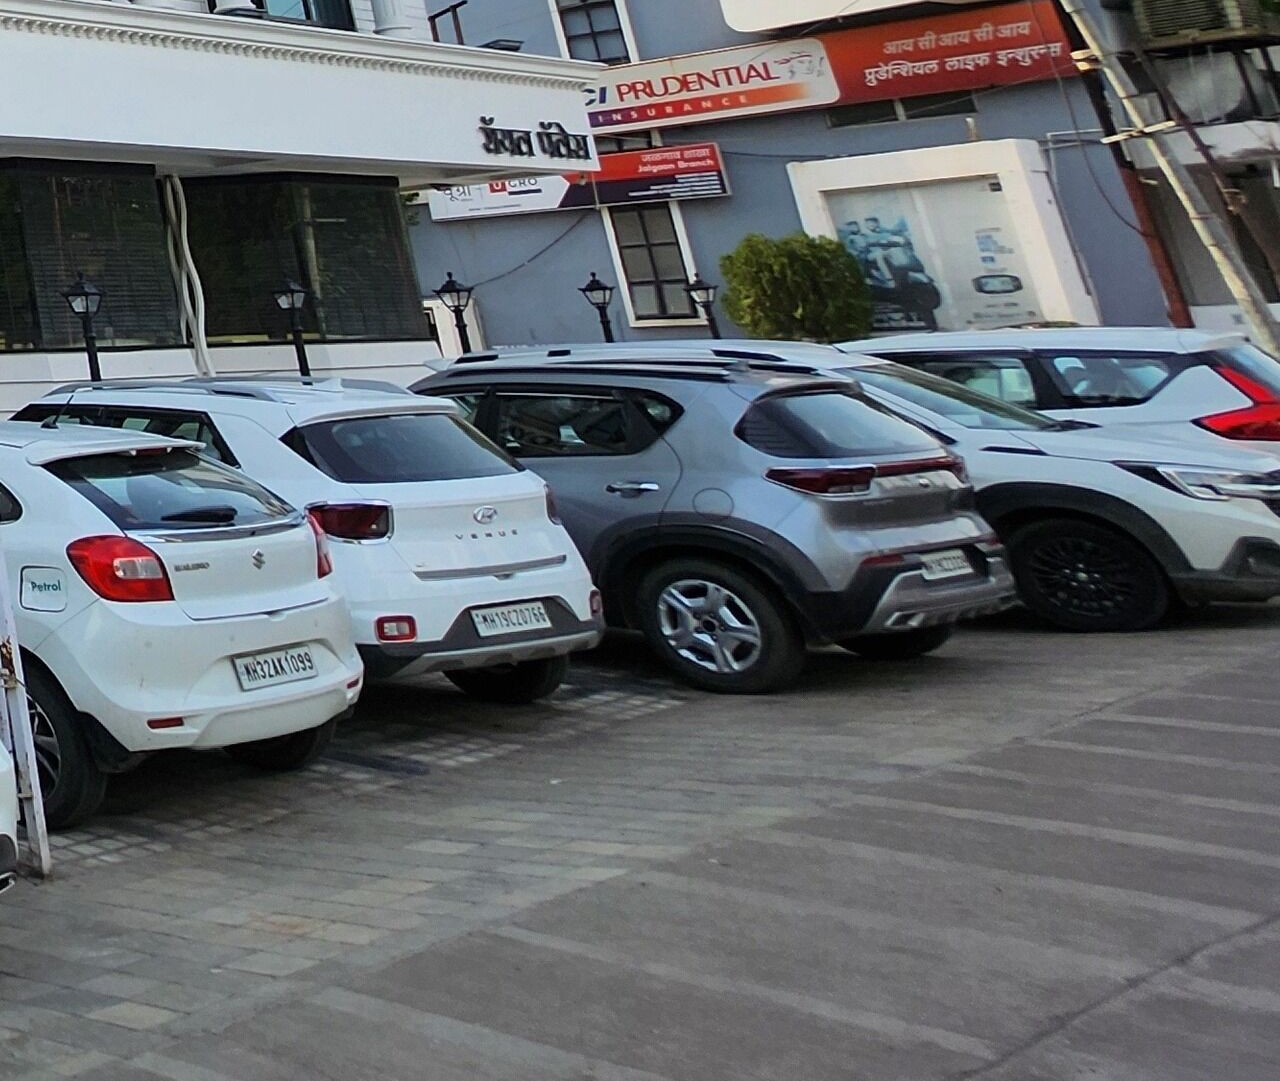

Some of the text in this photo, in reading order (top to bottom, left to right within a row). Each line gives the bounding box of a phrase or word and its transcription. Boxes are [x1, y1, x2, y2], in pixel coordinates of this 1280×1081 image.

[883, 21, 1031, 55] आय सी आय सी आय
[615, 61, 781, 103] PRUDENTIAL
[597, 94, 749, 123] INSURANCE
[30, 580, 62, 592] Petrol
